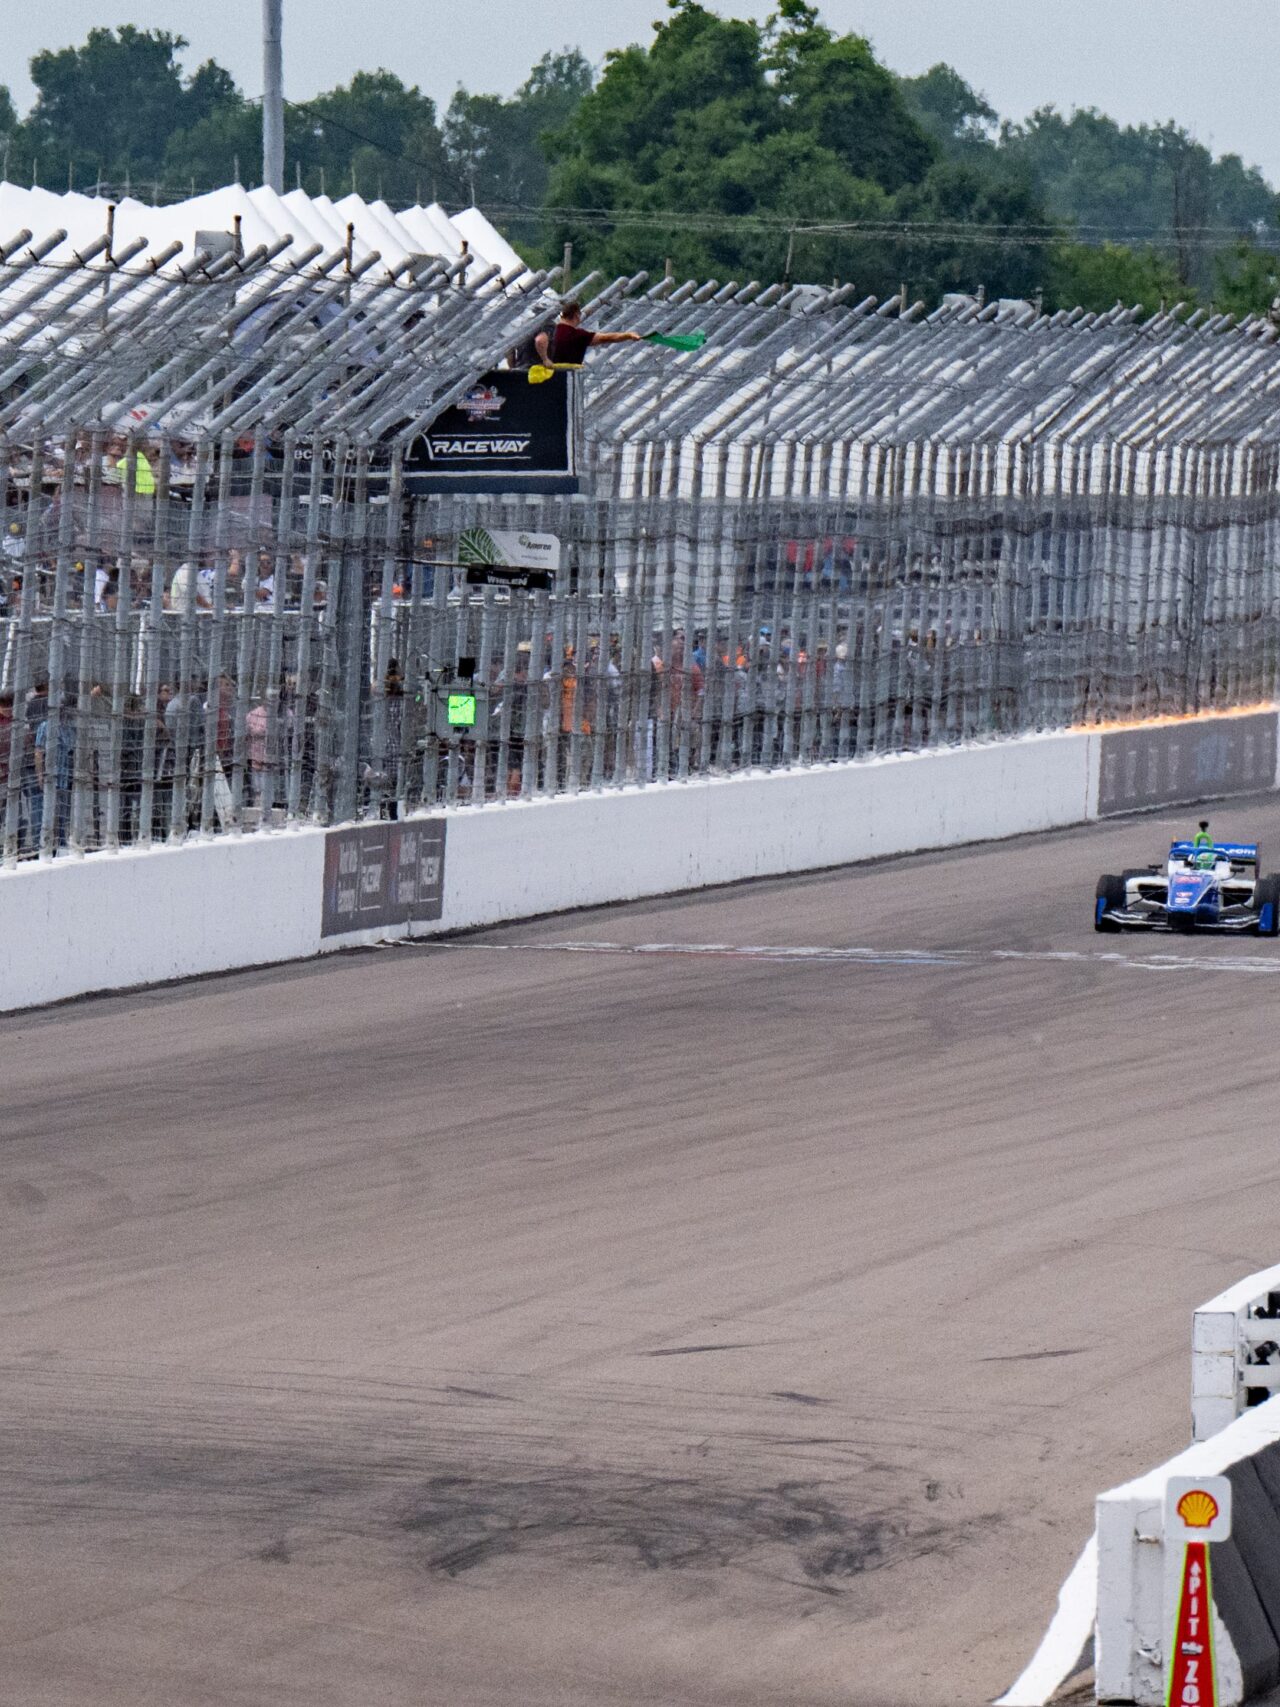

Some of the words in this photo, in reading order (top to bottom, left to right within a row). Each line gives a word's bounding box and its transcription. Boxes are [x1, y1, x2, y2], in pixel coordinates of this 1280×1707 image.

[432, 440, 530, 454] RACEWAY
[1188, 1576, 1201, 1637] PIT
[1181, 1660, 1201, 1707] ZO
